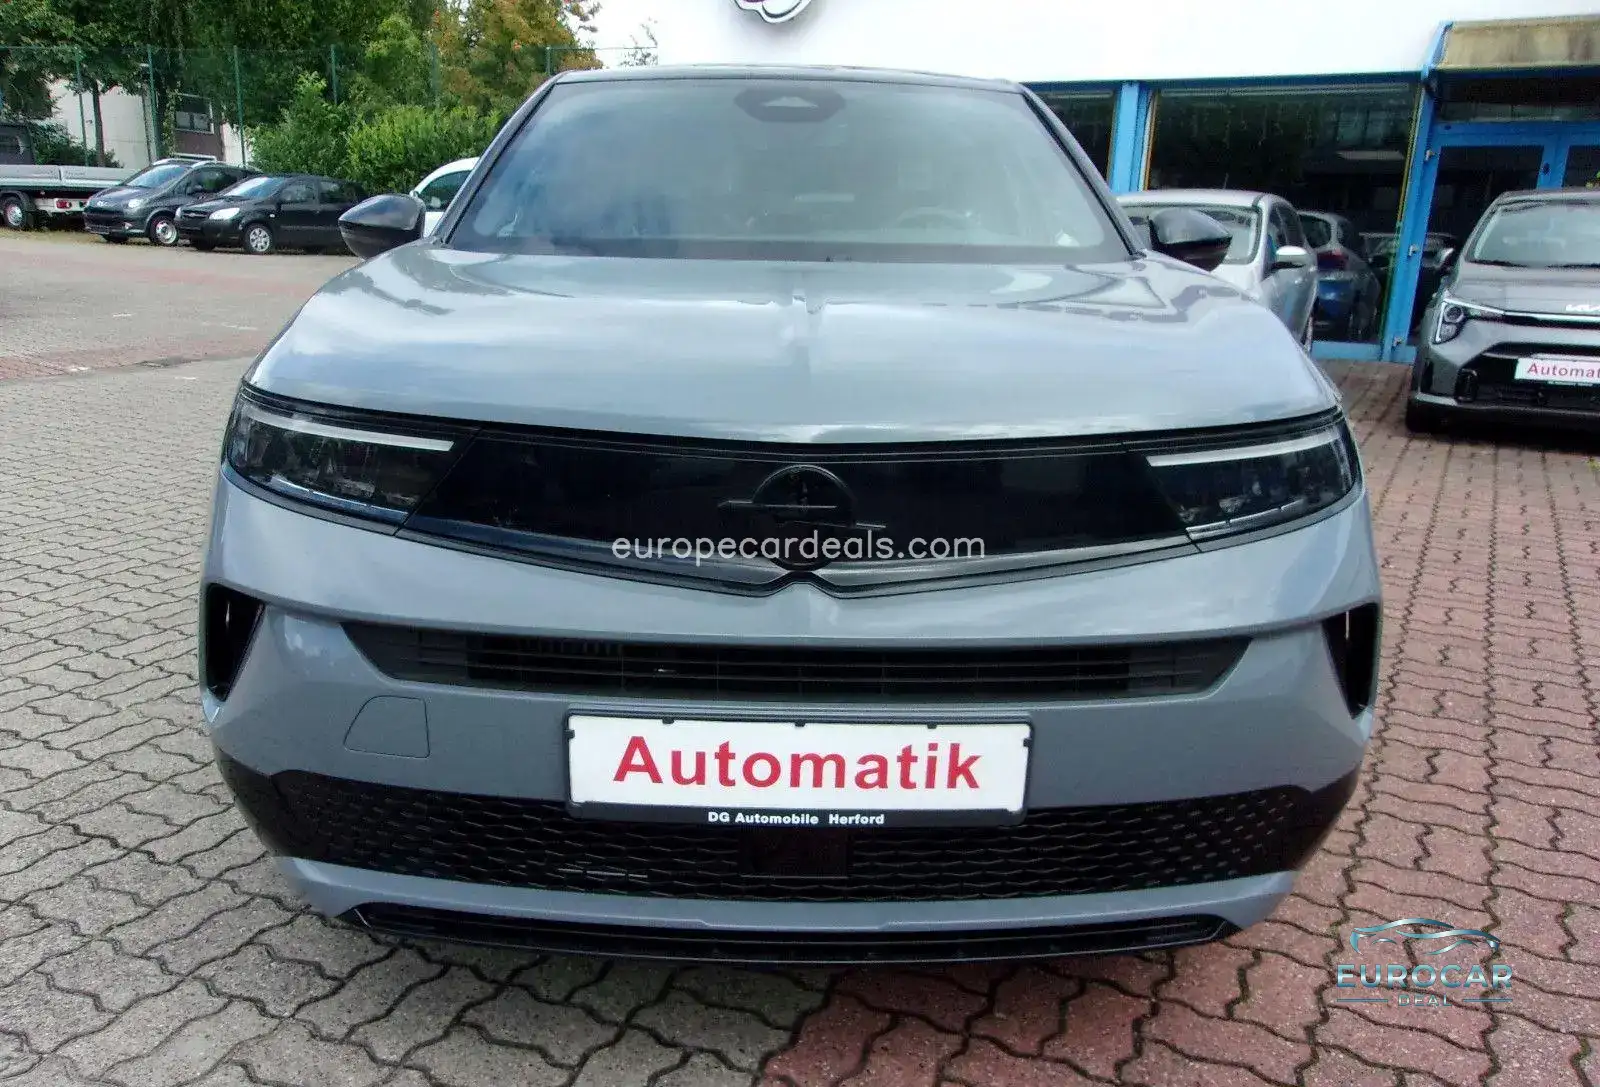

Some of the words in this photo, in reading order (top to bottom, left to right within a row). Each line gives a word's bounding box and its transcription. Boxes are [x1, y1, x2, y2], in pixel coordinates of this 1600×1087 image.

[612, 735, 983, 790] Automatik
[707, 811, 730, 823] DG
[734, 812, 819, 825] Automobile
[828, 813, 886, 825] Herford
